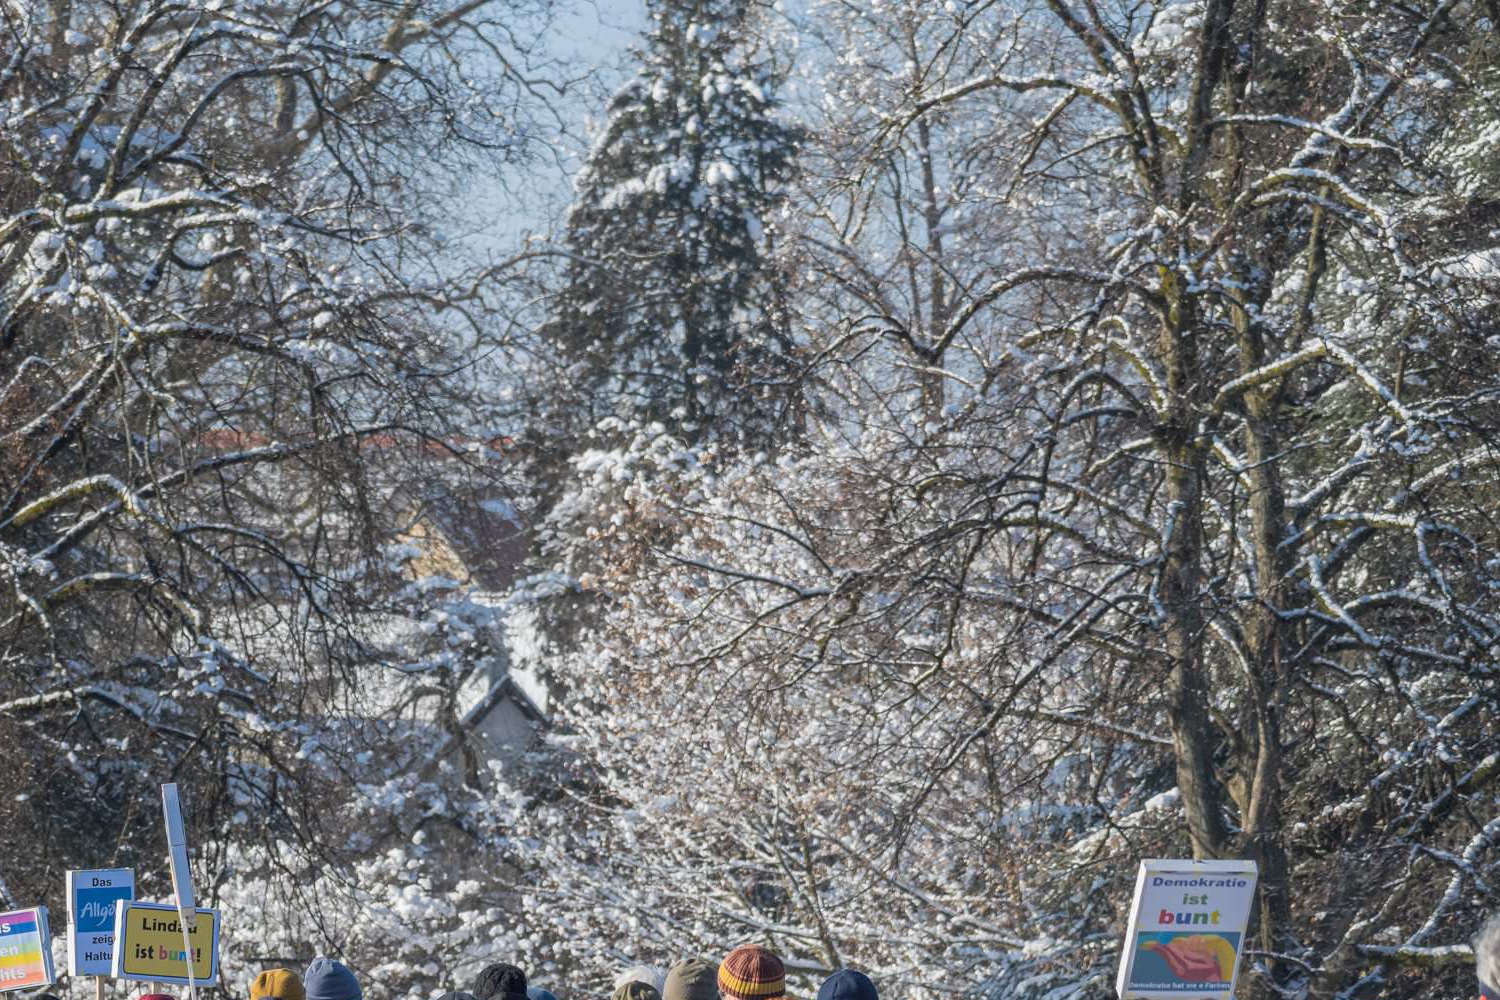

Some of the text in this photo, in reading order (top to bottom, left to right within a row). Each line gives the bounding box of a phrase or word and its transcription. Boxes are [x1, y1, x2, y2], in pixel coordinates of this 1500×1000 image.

[92, 877, 112, 887] Das
[1152, 877, 1247, 888] Demokratie
[1182, 893, 1208, 905] ist
[1158, 909, 1221, 925] bunt
[92, 934, 113, 945] zeig
[85, 951, 113, 962] Haltu
[135, 943, 154, 960] ist
